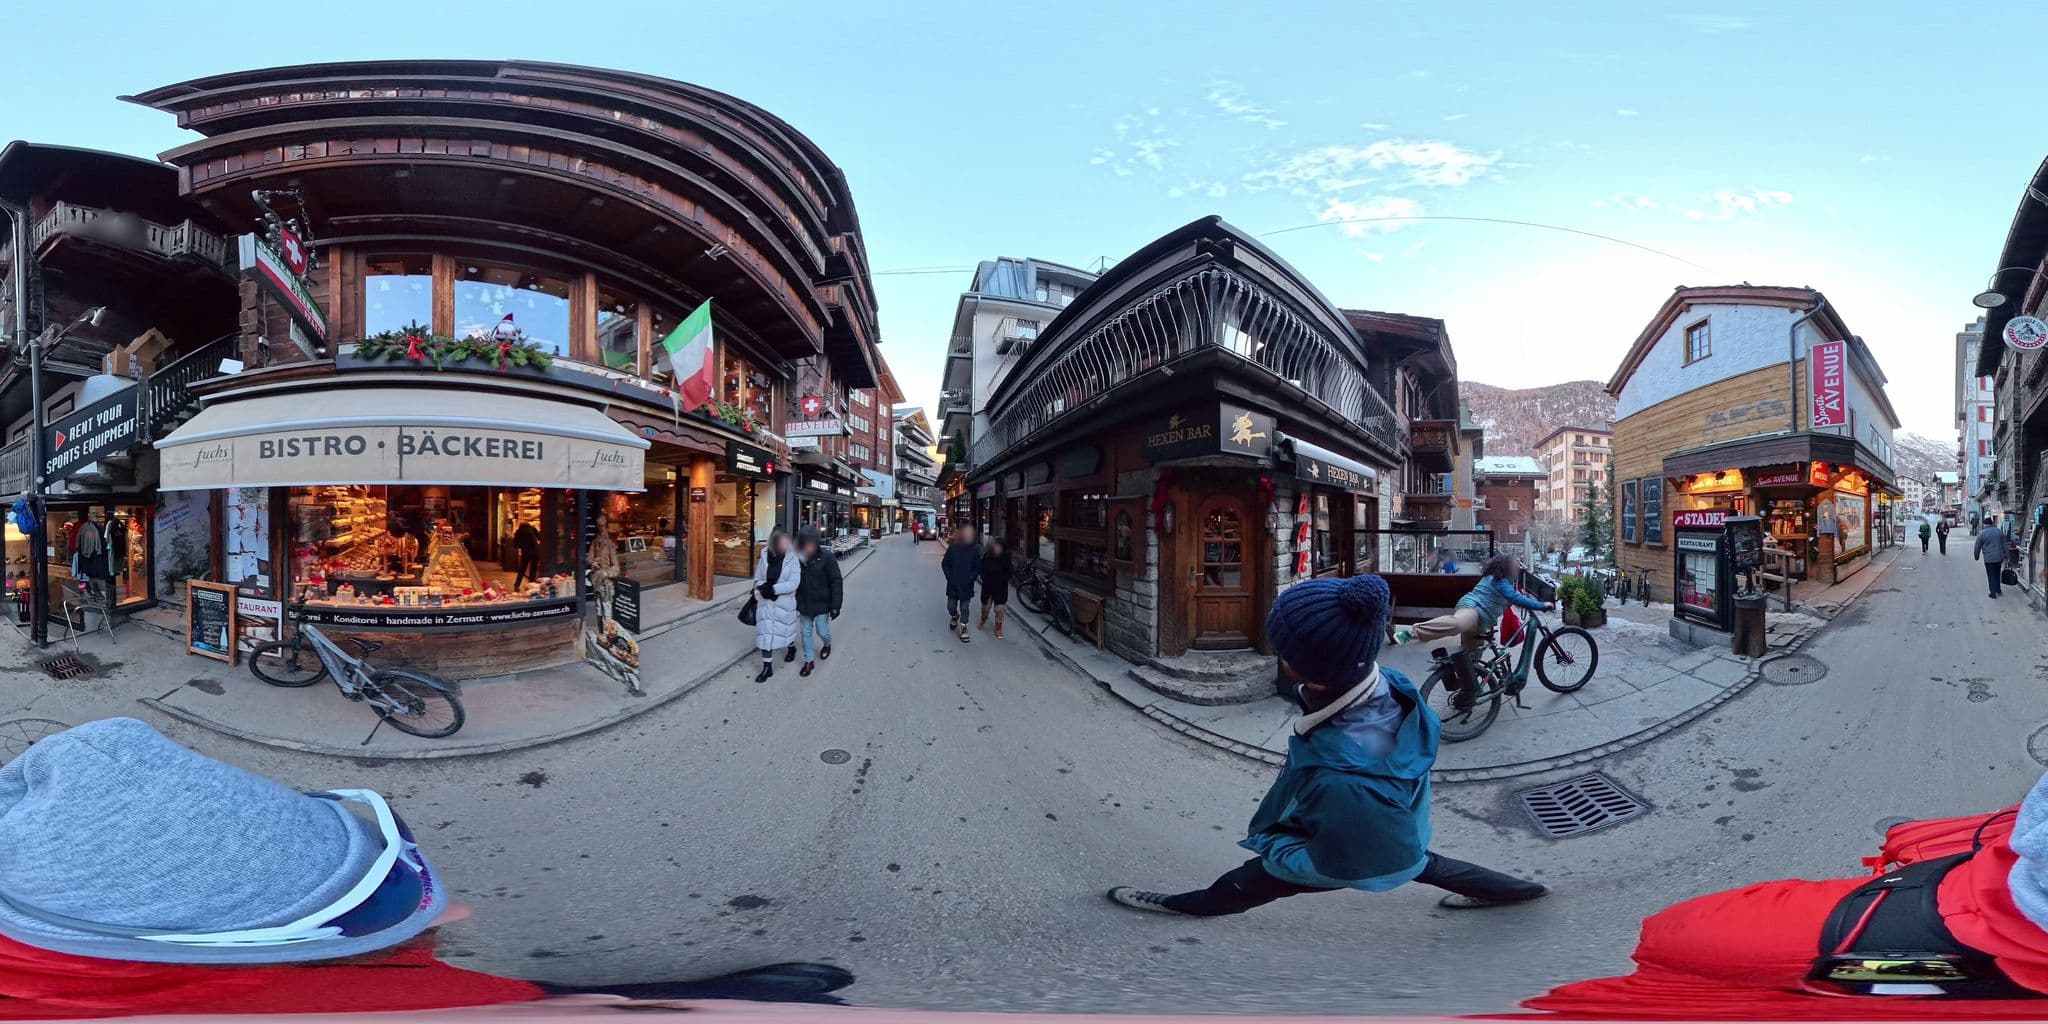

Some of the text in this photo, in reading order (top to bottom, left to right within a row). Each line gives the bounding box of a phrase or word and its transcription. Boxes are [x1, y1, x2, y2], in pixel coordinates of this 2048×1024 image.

[1824, 345, 1840, 411] AVENUE
[69, 404, 122, 441] RENT YOUR
[785, 420, 839, 431] HELVETIA
[259, 430, 543, 460] BISTRO BÄCKEREI
[1148, 424, 1212, 447] HEXEN BAR
[46, 417, 136, 475] SPORTS EQUIPMENT
[193, 444, 228, 468] fuchs
[591, 449, 624, 468] fuchs
[1328, 465, 1349, 481] HEXEN
[1349, 472, 1360, 484] BAR
[1773, 474, 1799, 483] AVENUE
[1684, 512, 1726, 526] STADEL
[237, 602, 278, 614] TAURANT
[333, 615, 378, 624] Konditorei
[386, 617, 432, 625] handmade
[435, 616, 444, 624] in
[446, 615, 484, 624] Zermatt
[490, 606, 570, 621] www.fuchs-zermatt.ch
